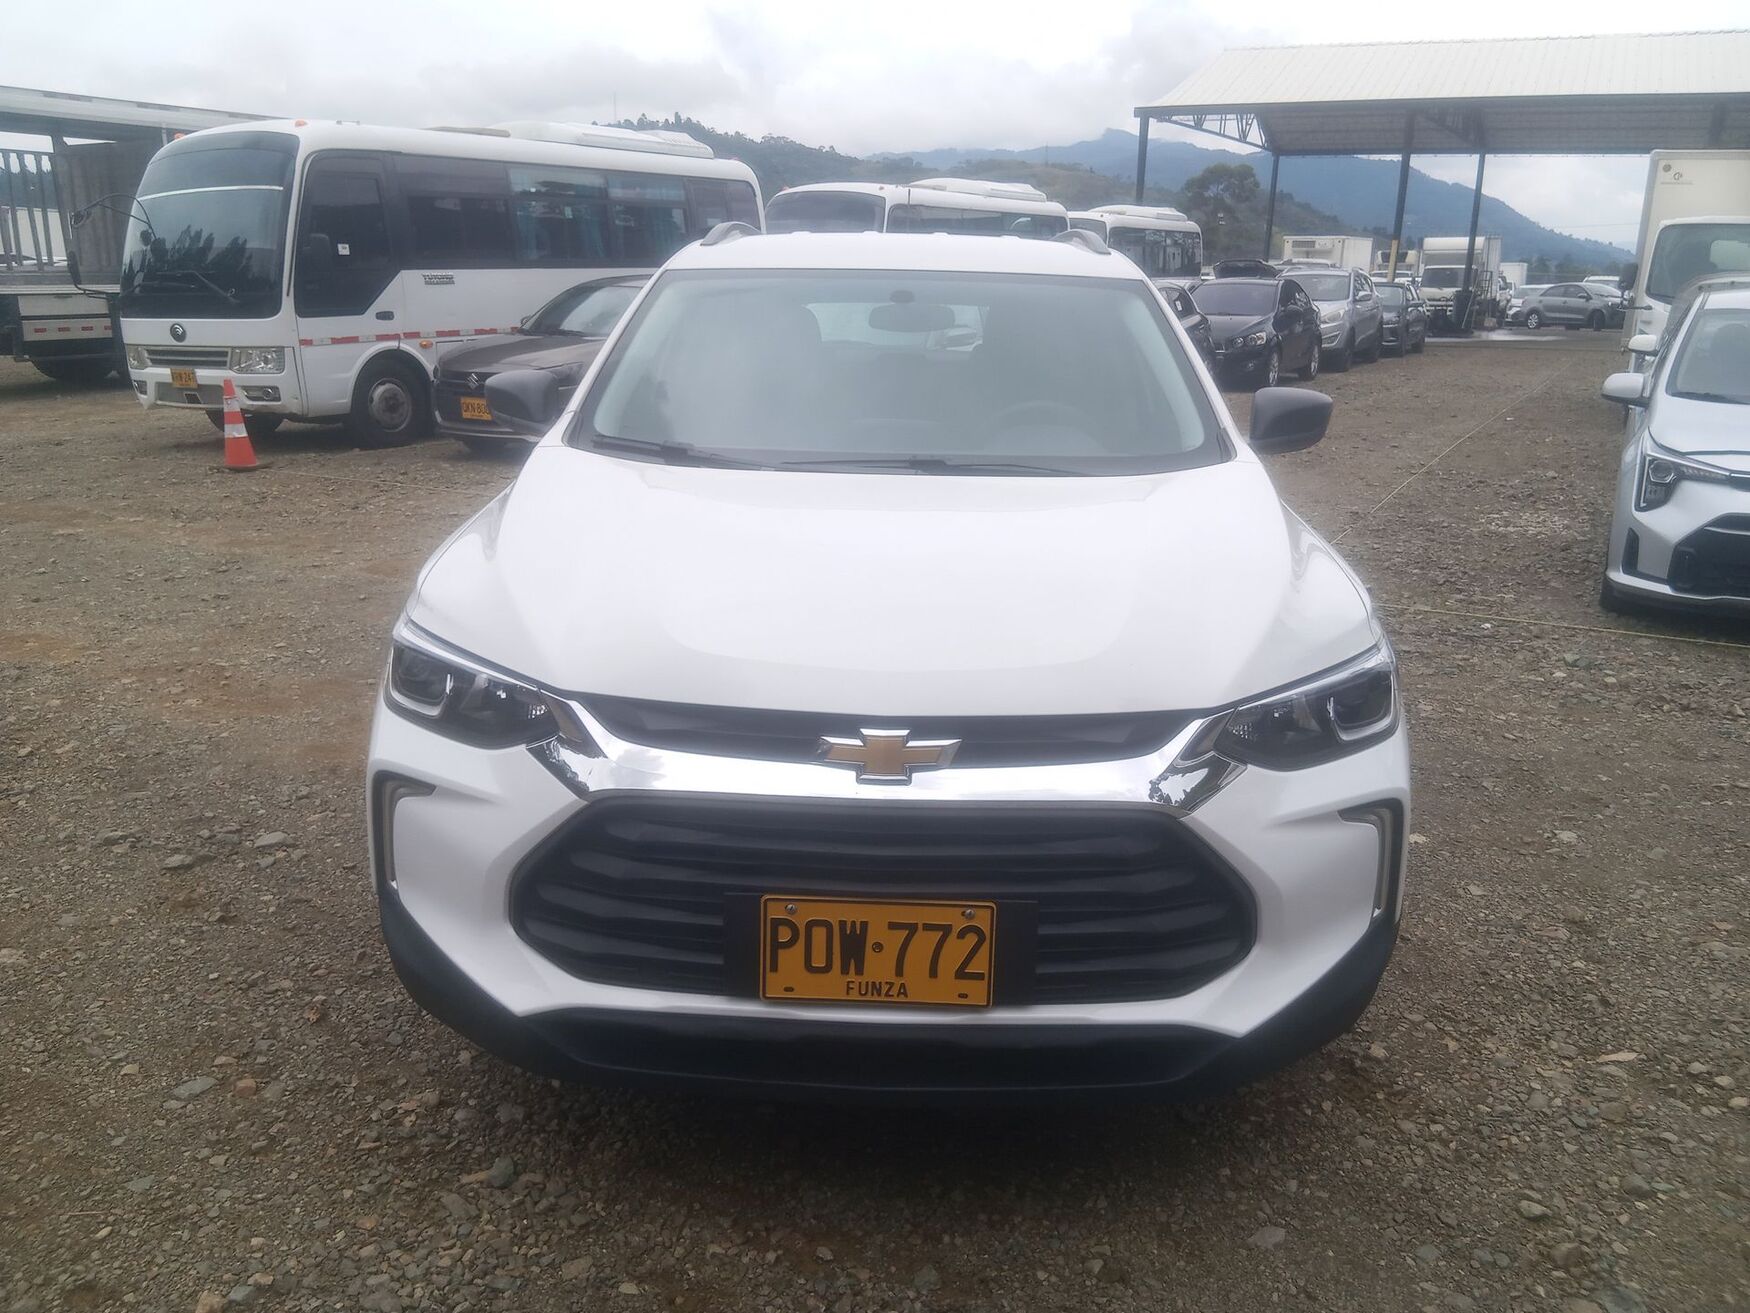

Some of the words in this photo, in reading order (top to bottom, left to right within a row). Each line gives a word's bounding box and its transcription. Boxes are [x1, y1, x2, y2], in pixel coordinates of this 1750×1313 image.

[769, 918, 868, 975] POW
[888, 921, 986, 980] 772
[846, 980, 909, 998] FUNZA
